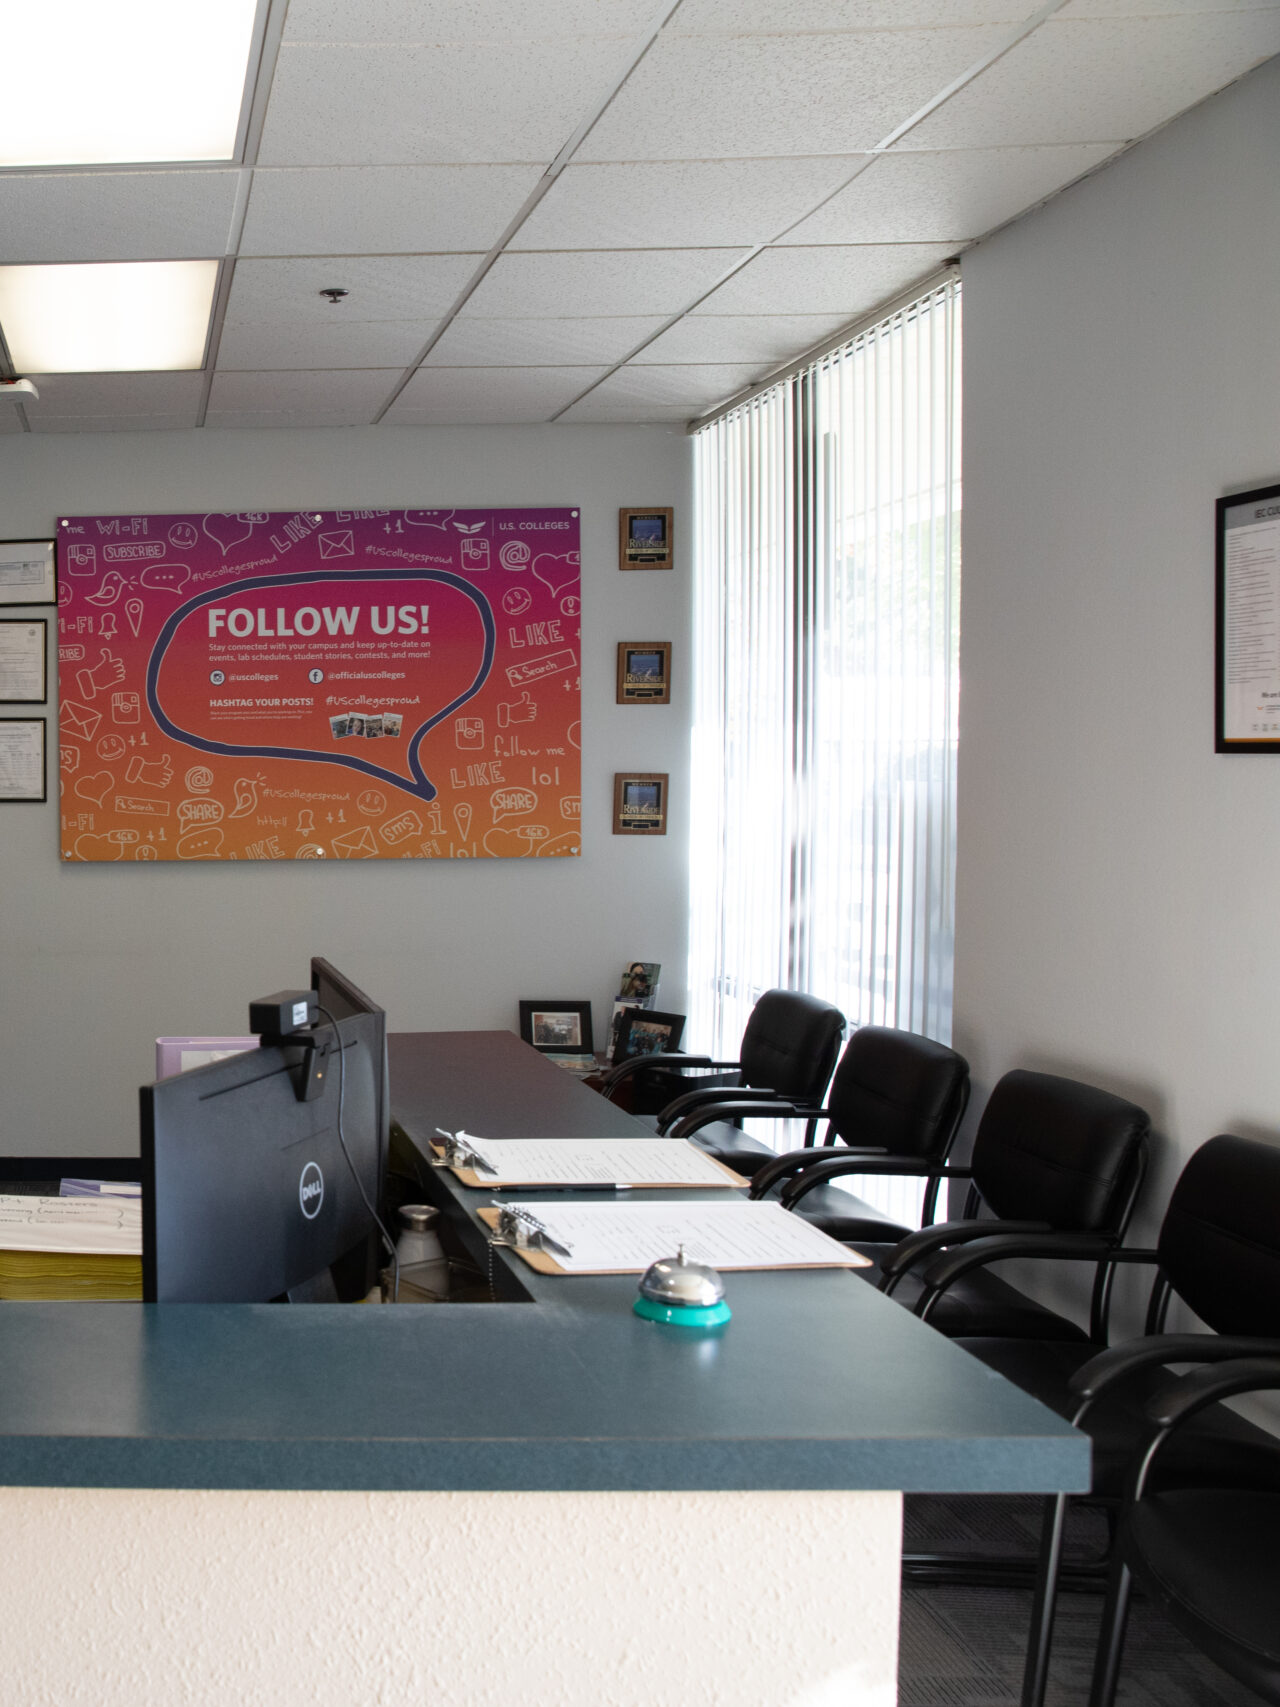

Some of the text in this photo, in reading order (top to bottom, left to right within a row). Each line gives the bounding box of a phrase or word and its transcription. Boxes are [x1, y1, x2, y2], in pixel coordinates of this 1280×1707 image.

[499, 521, 570, 531] U.S. COLLEGES
[107, 545, 162, 559] SUBSCRIBE
[365, 545, 454, 565] #UScollegesproud
[191, 554, 279, 582] #UScollegesproud
[208, 605, 430, 638] FOLLOW US!
[509, 619, 564, 649] LIKE
[209, 643, 226, 652] Stay
[228, 642, 268, 651] connected
[269, 642, 287, 650] with
[289, 643, 306, 652] your
[308, 642, 339, 652] campus
[340, 641, 355, 649] and
[356, 641, 376, 650] keep
[377, 640, 418, 650] up-to-date
[209, 650, 430, 662] events, lab schedules, student stories, contests, and more!
[229, 671, 406, 682] @uscolleges @officialuscolleges
[521, 660, 558, 678] Search
[209, 697, 314, 708] HASHTAG YOUR POSTS!
[325, 695, 420, 709] #UScollegesproud
[494, 735, 565, 756] follow me
[450, 761, 505, 789] LIKE
[532, 767, 560, 786] lol
[262, 788, 351, 802] #UScollegesproud
[495, 792, 533, 810] SHARE
[127, 800, 155, 812] Search
[182, 804, 219, 820] SHARE
[302, 1181, 322, 1201] DELL
